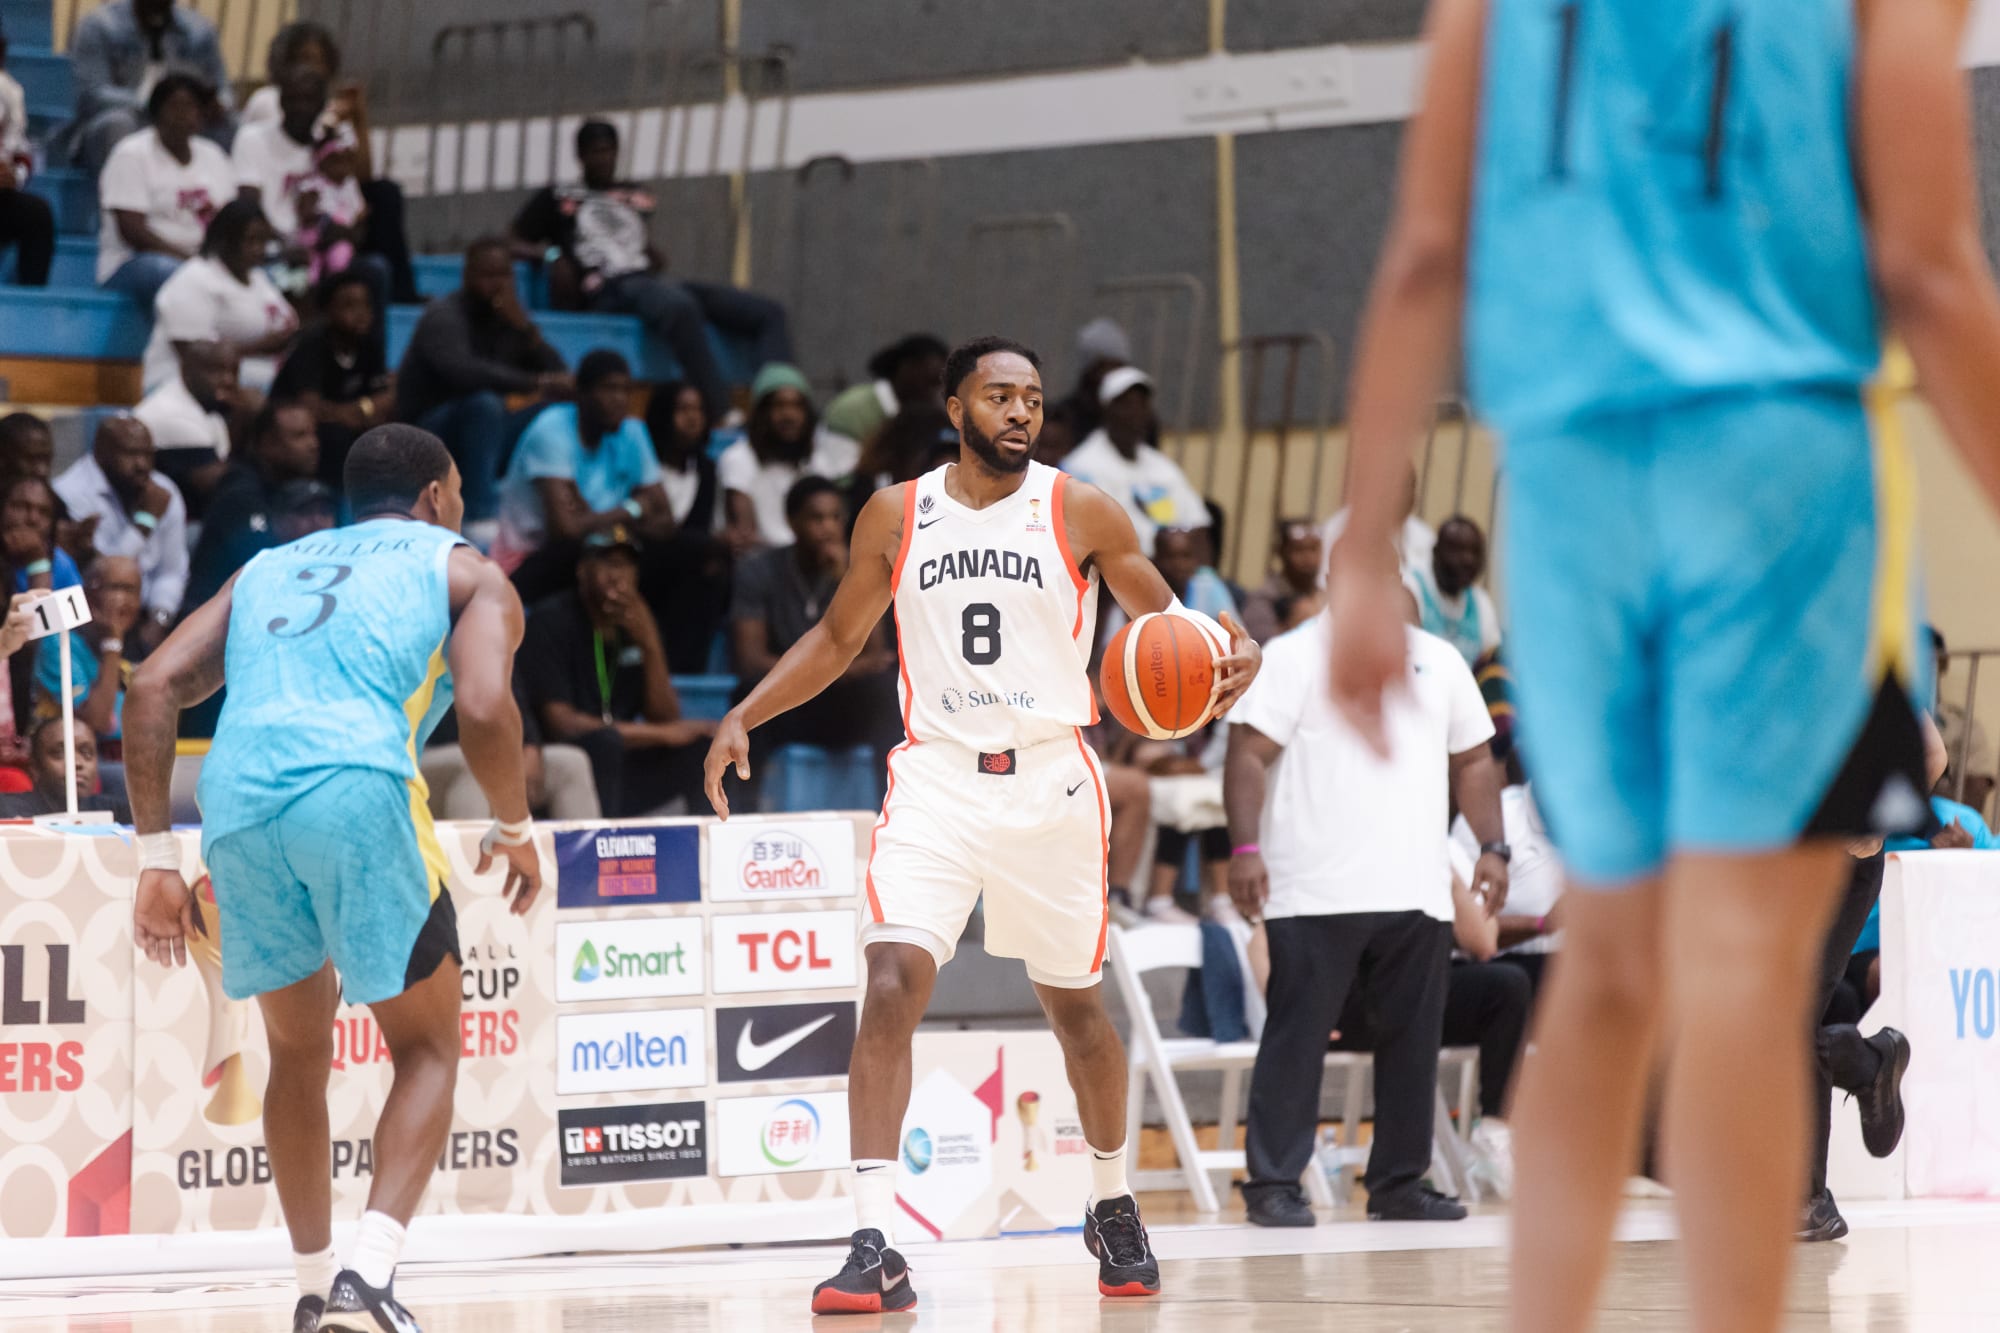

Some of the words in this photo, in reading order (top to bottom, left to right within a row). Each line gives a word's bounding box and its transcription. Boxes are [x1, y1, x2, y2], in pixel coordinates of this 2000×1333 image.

[919, 549, 1044, 591] CANADA
[35, 604, 50, 631] 1
[67, 594, 79, 621] 1
[266, 564, 353, 639] 3
[961, 602, 1002, 666] 8
[1150, 641, 1168, 698] molten
[467, 944, 517, 960] ALL
[604, 942, 686, 978] Smart
[738, 930, 832, 973] TCL
[0, 944, 86, 1025] LL
[462, 967, 520, 1001] CUP
[1948, 967, 2000, 1041] YO
[331, 1009, 520, 1071] QUAERS
[572, 1031, 687, 1072] molten
[0, 1040, 85, 1092] ERS
[602, 1119, 701, 1152] TISSOT
[1055, 1125, 1084, 1137] WORL
[177, 1147, 274, 1190] GLOB
[567, 1156, 598, 1167] SWISS
[600, 1152, 645, 1164] WATCHES
[646, 1150, 677, 1161] SINCE
